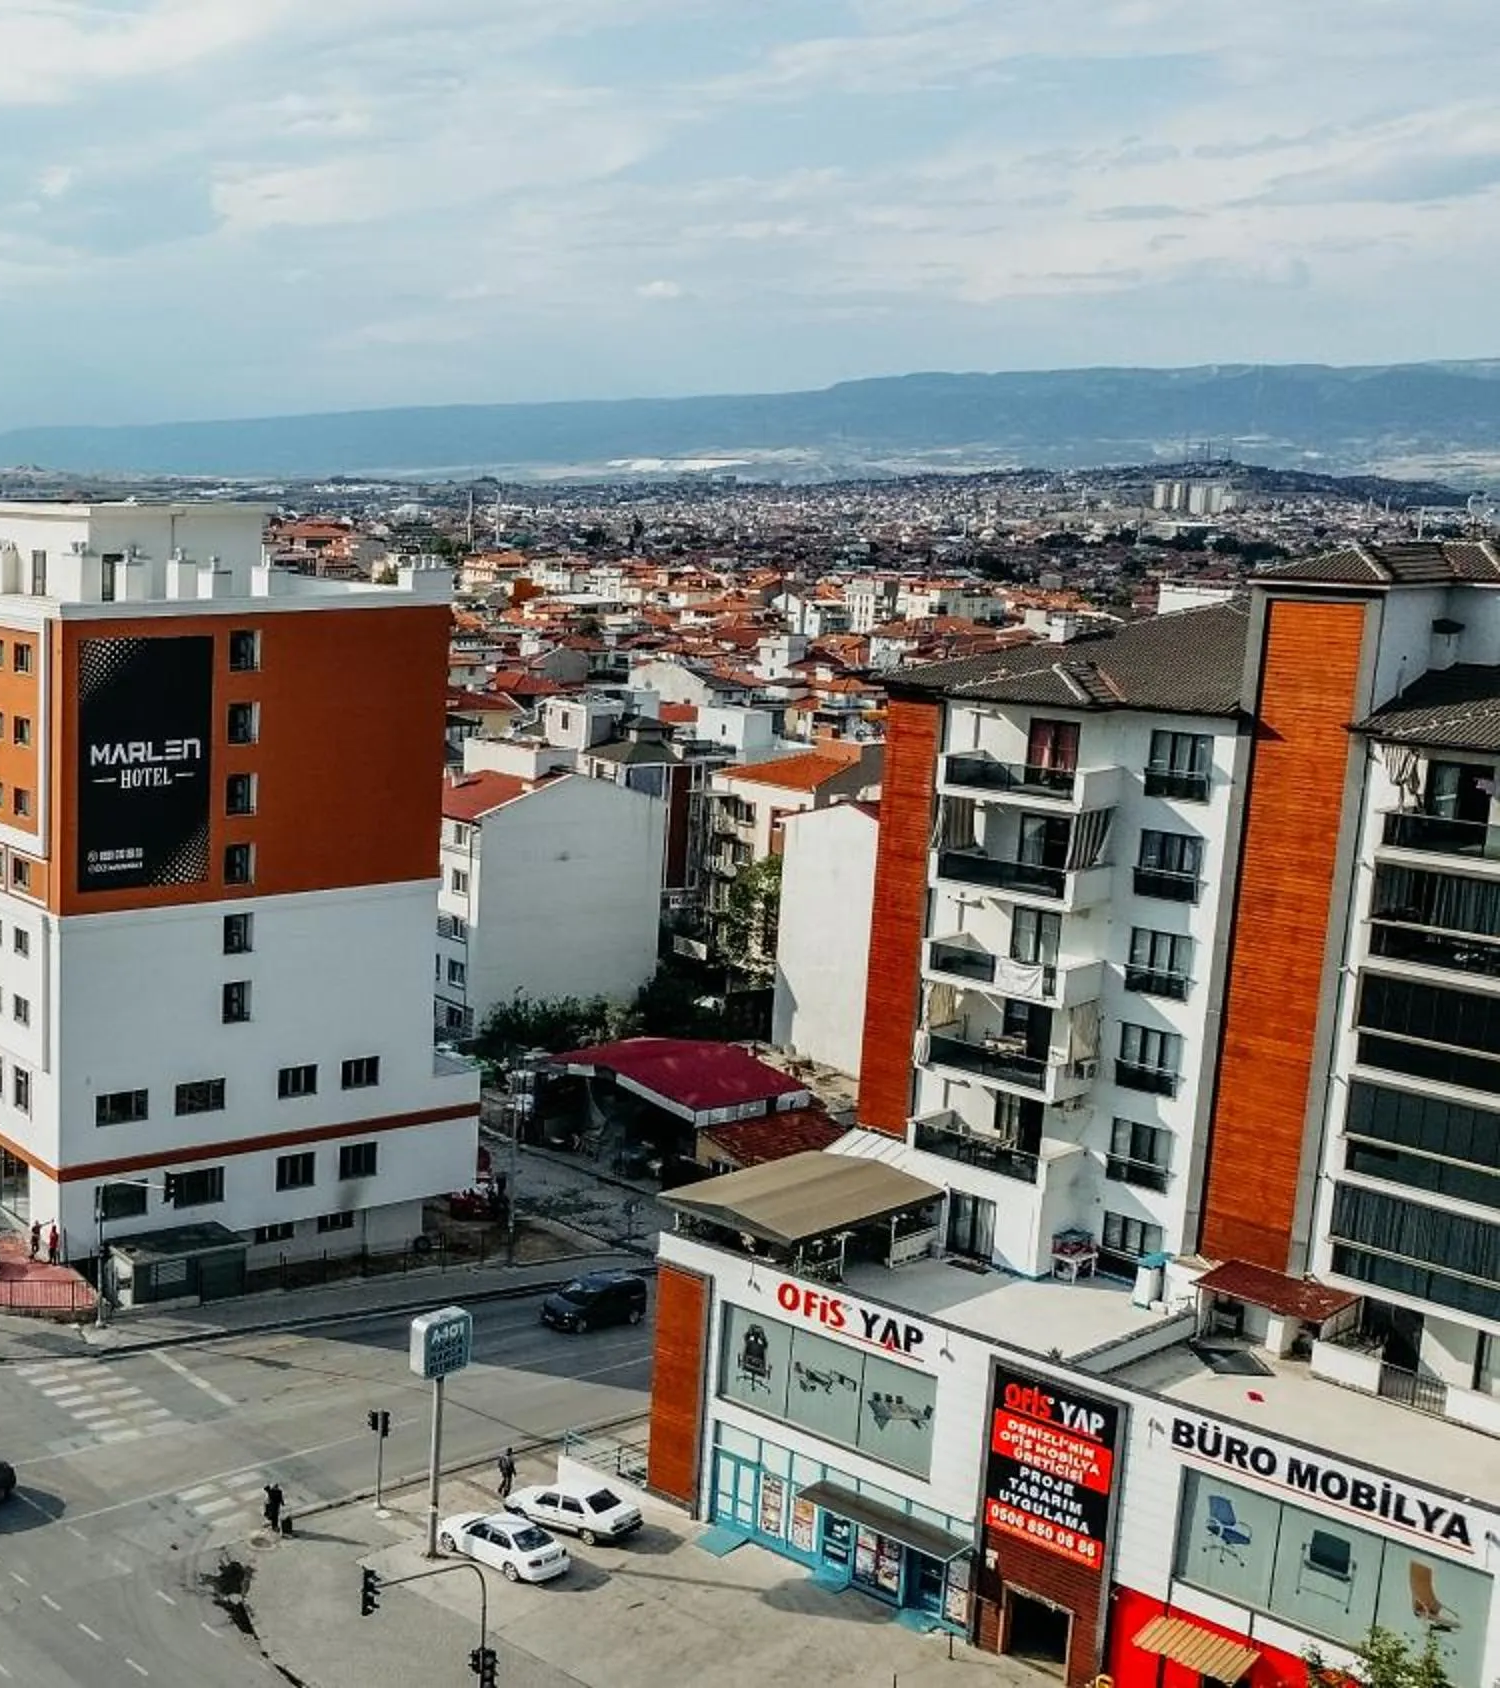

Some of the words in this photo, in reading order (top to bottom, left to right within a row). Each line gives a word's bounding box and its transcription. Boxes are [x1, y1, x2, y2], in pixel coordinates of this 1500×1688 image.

[90, 738, 200, 766] MARLEN
[120, 767, 173, 789] HOTEL
[860, 1308, 924, 1352] YAP
[1060, 1401, 1104, 1435] YAP
[1036, 1442, 1100, 1475] MOBİLYA
[1009, 1477, 1083, 1515] TASARIM
[1019, 1466, 1074, 1497] PROJE
[1171, 1417, 1277, 1476] BÜRO
[1287, 1457, 1472, 1547] MOBİLYA
[999, 1489, 1090, 1534] UYGULAMA
